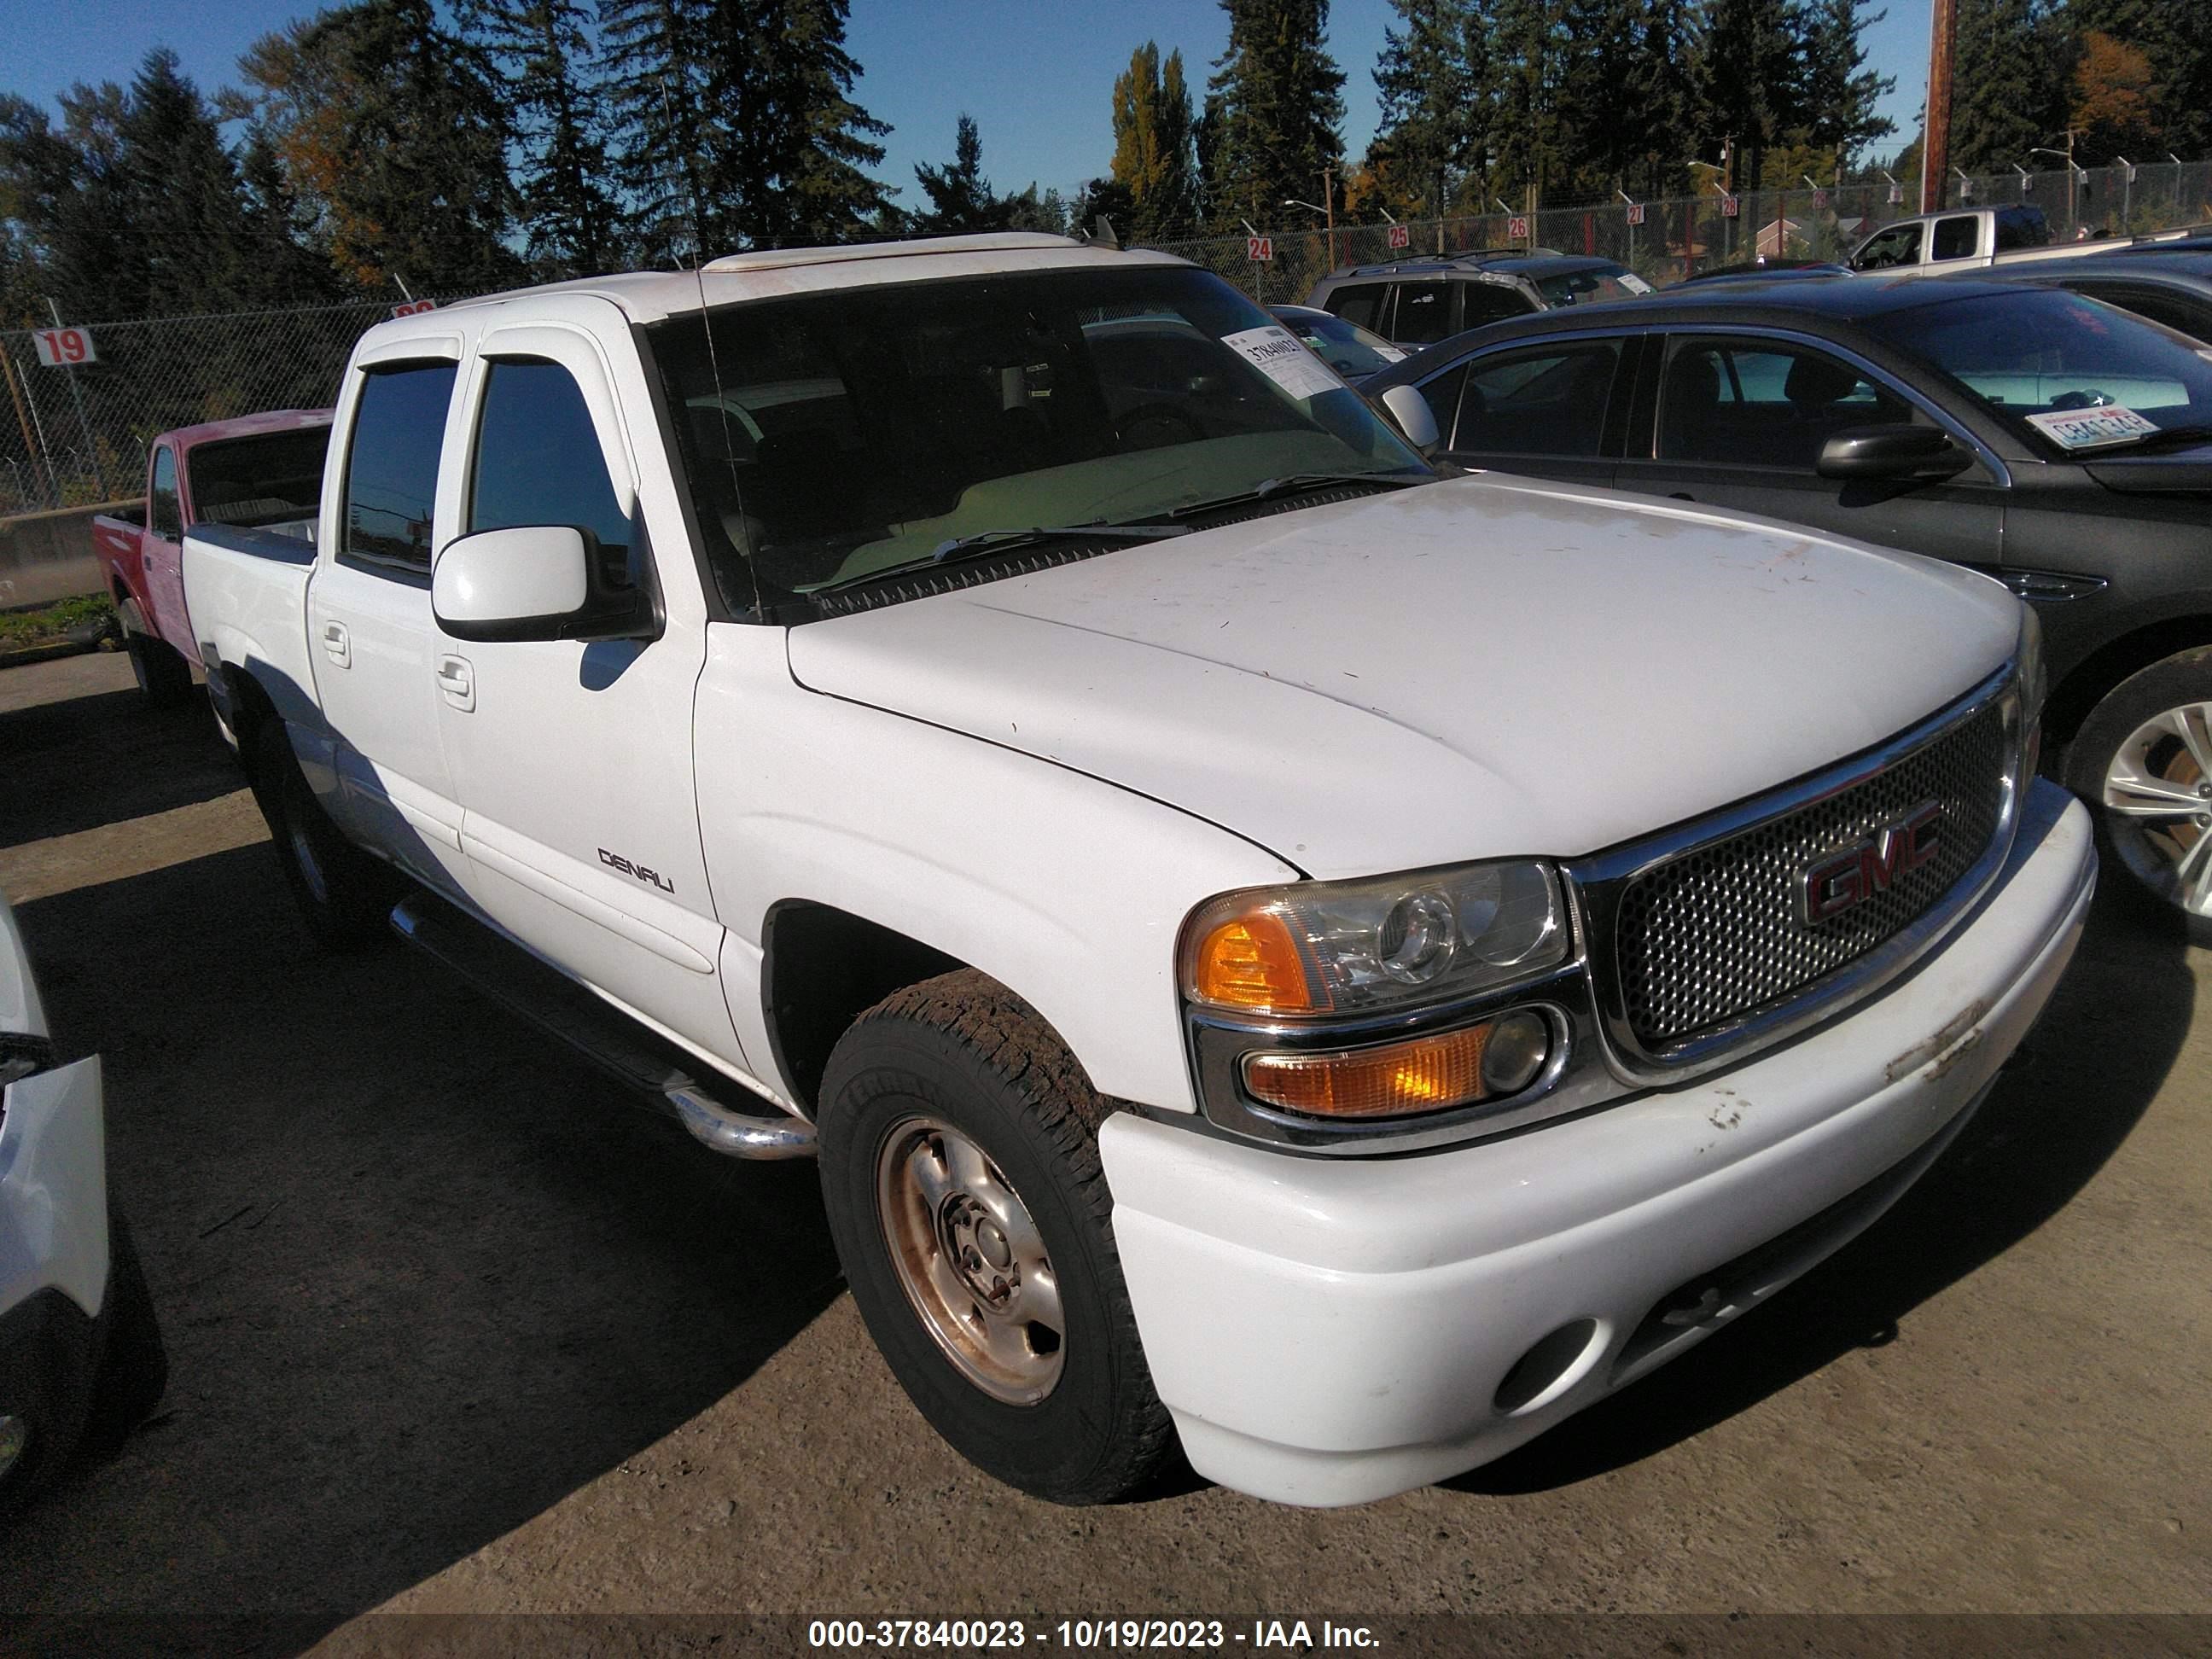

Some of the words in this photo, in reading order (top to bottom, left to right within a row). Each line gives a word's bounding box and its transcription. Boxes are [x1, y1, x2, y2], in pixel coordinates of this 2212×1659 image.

[1628, 206, 1642, 223] 27
[1724, 200, 1736, 215] 28
[1390, 226, 1407, 247] 25
[1510, 218, 1526, 237] 26
[1249, 238, 1271, 259] 24
[44, 329, 85, 363] 19
[1246, 339, 1301, 362] 37840023
[597, 847, 676, 894] DENALI
[1796, 797, 1941, 927] GMC
